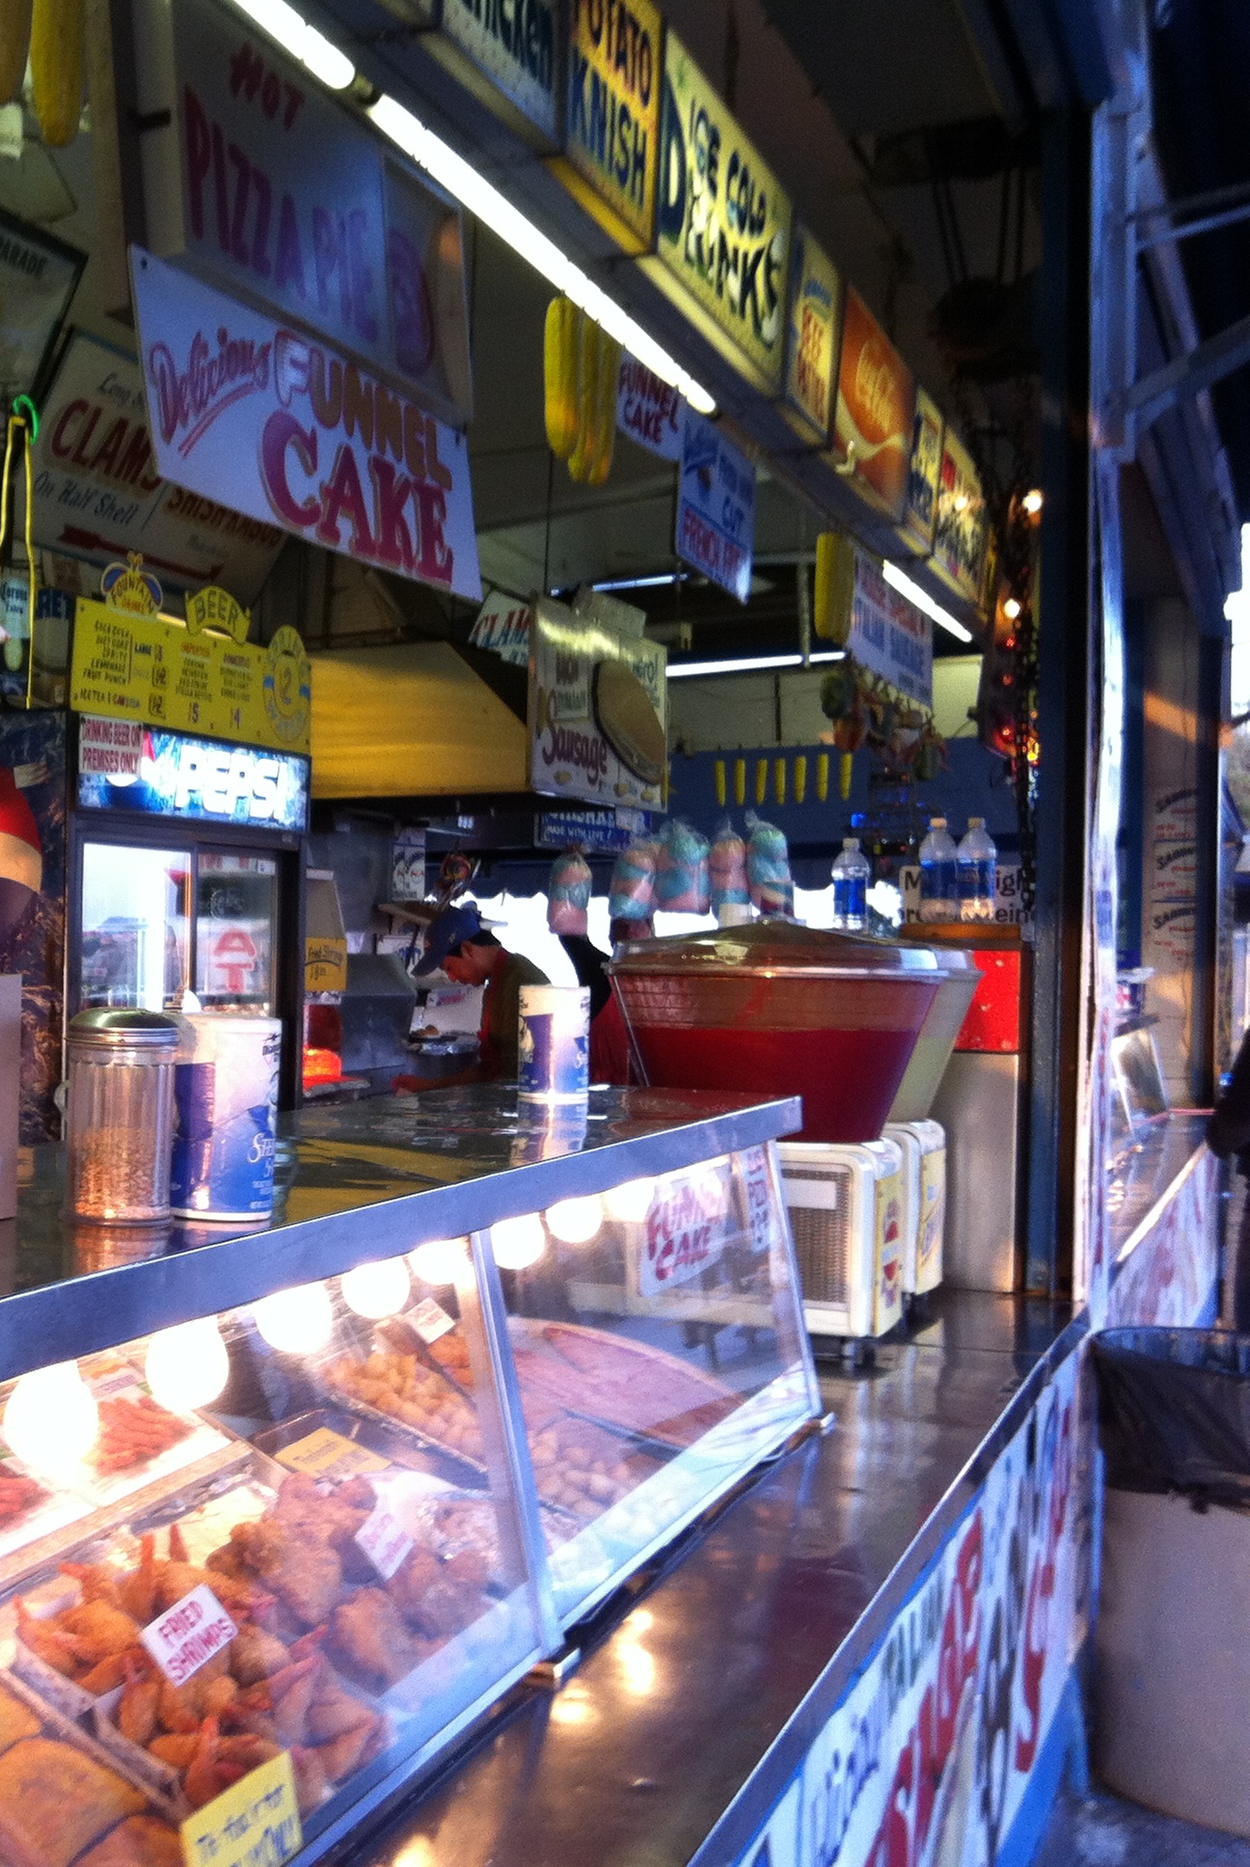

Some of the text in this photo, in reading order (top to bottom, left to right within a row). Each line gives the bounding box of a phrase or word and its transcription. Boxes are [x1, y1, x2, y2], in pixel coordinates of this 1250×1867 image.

[230, 39, 305, 130] HOT
[567, 44, 647, 213] KNISH
[182, 84, 306, 298] PIZZA
[726, 149, 767, 239] COLD
[150, 326, 453, 492] Delicious FUNNEL
[623, 396, 663, 446] CAKE
[94, 492, 141, 526] Shell
[258, 409, 455, 588] CAKE
[1, 581, 29, 600] Corona
[194, 588, 240, 632] BEER
[82, 747, 139, 775] PREMISES ONLY
[113, 722, 131, 746] BEER
[174, 744, 290, 821] PEPSI
[158, 1600, 205, 1649] FRIED
[166, 1617, 237, 1681] SHRIMPS
